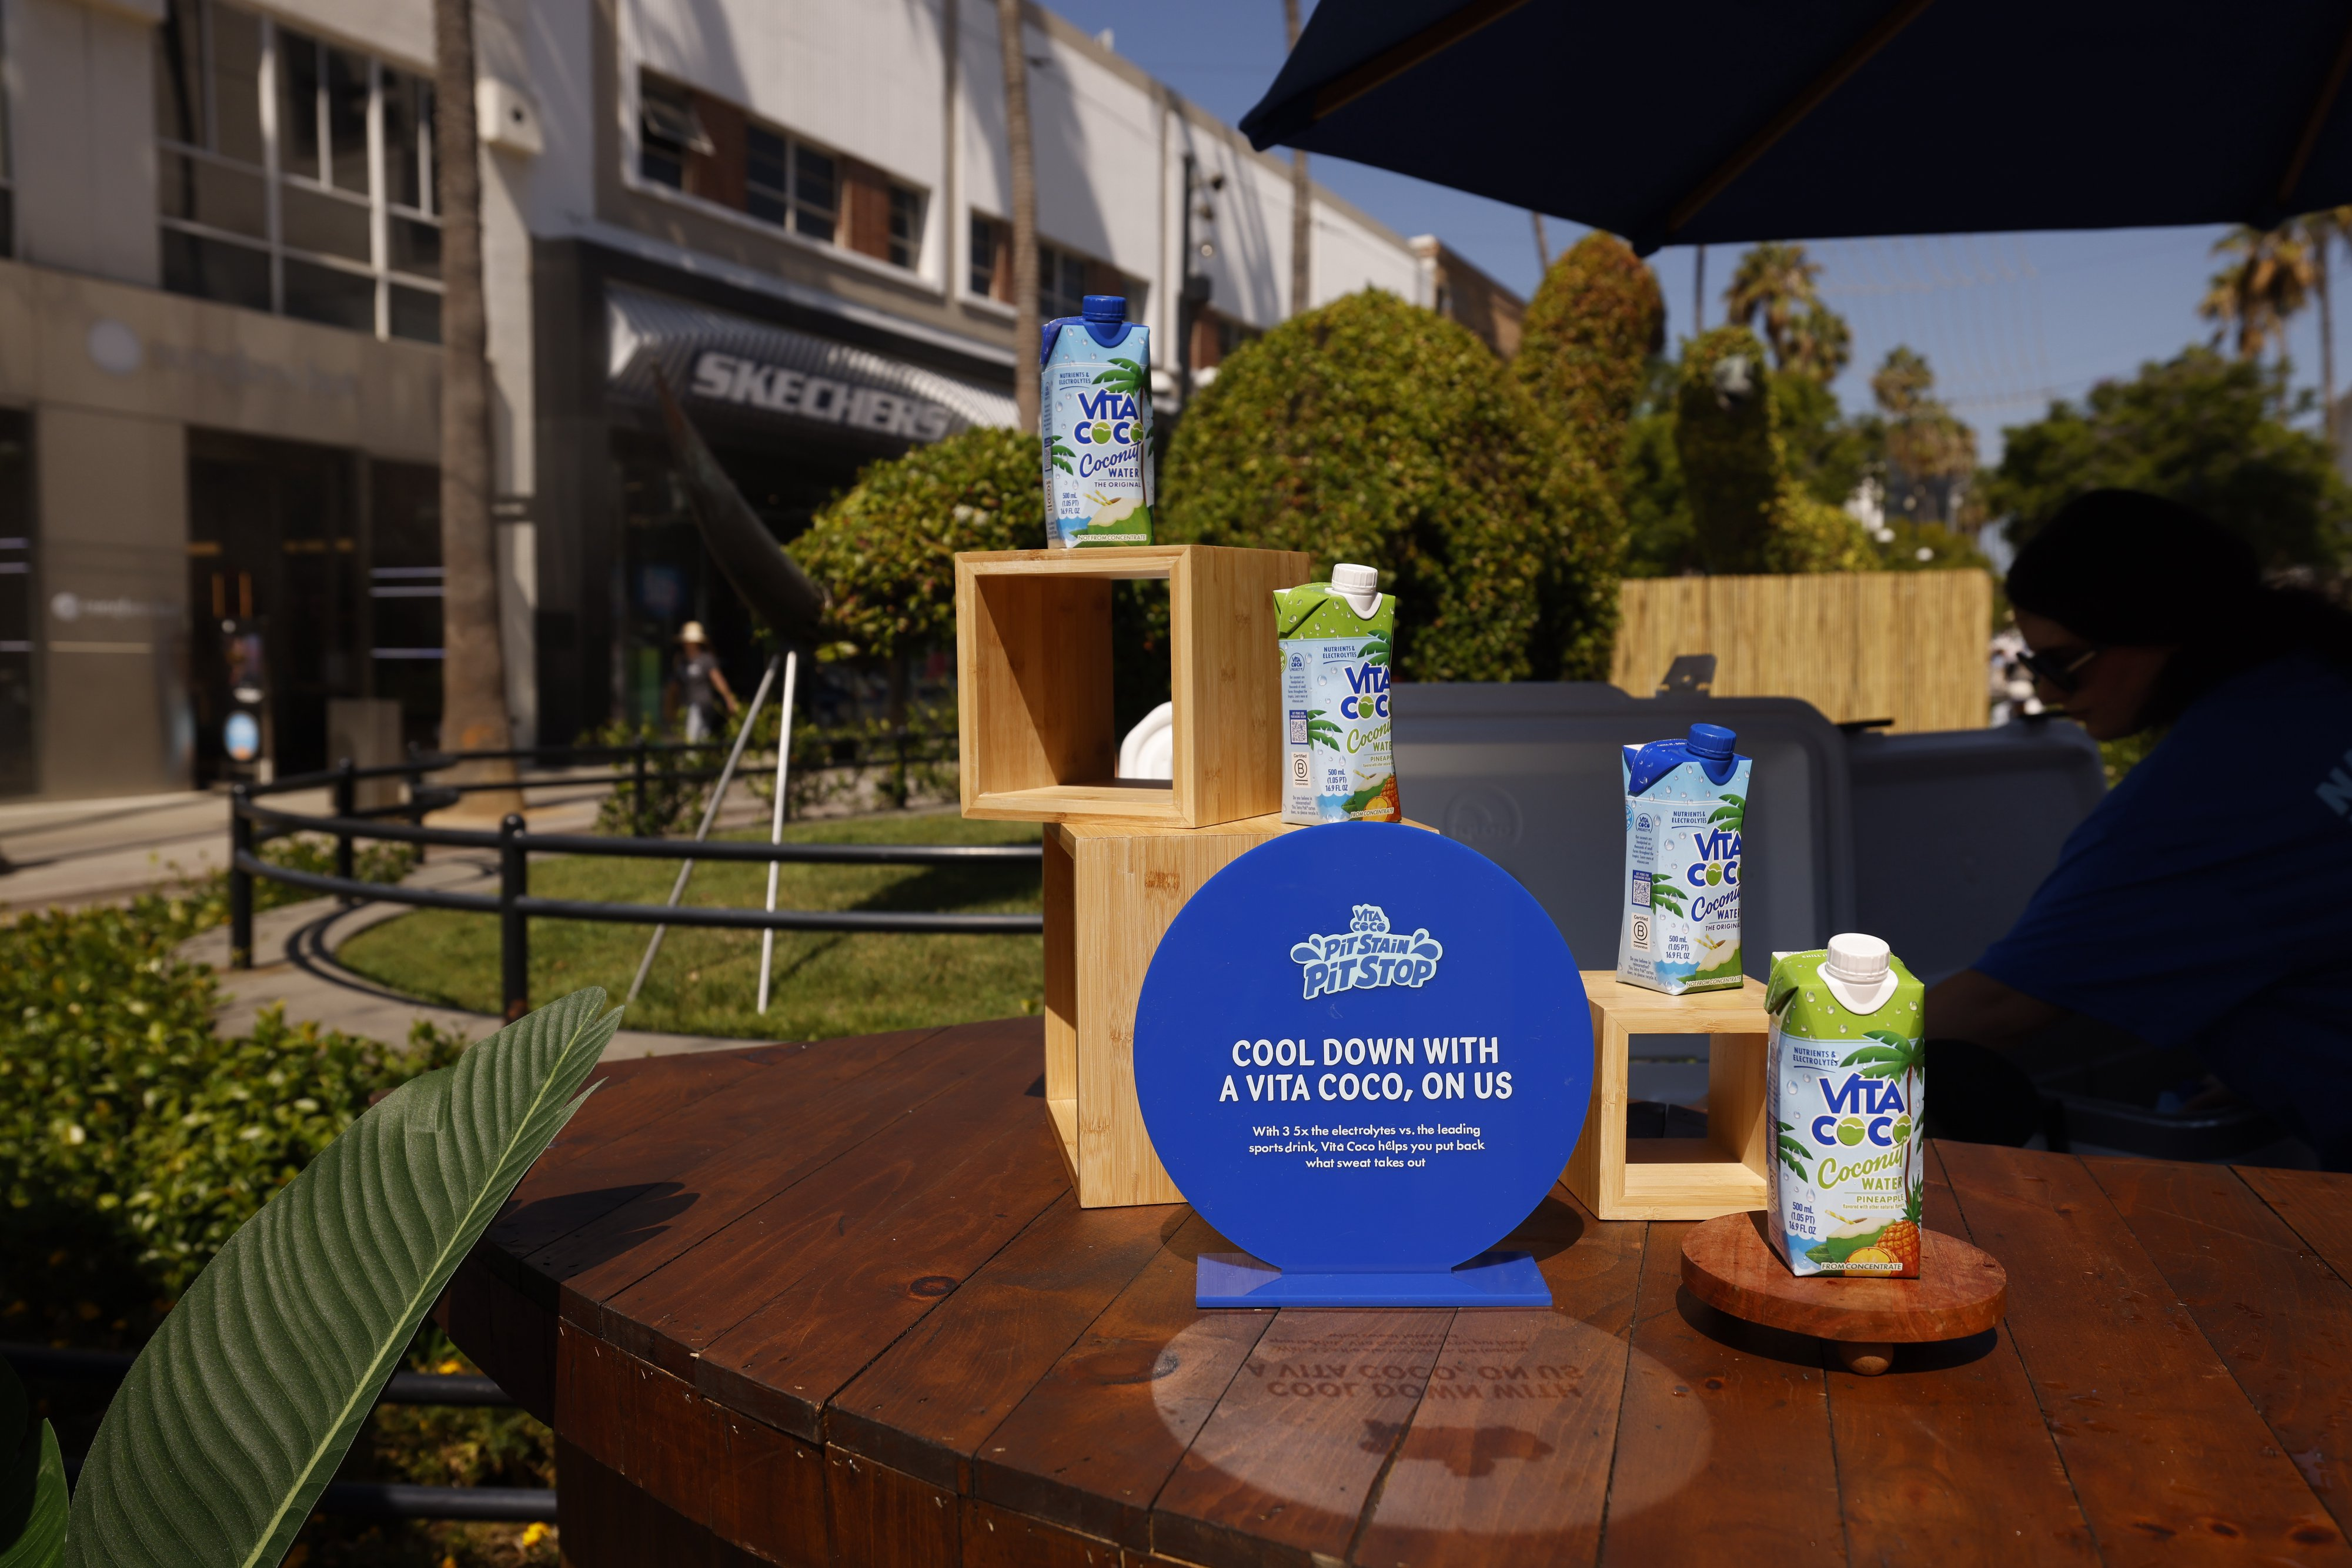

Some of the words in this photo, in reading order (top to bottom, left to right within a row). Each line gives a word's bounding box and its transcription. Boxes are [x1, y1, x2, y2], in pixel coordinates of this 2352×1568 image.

[691, 351, 951, 442] SKECHERS
[1077, 388, 1139, 420] VITA
[1074, 421, 1144, 444] COCO
[1080, 440, 1141, 478] Coconut
[1108, 468, 1139, 477] WATER
[1344, 661, 1390, 694] VITA
[1341, 694, 1391, 720] COC
[1373, 741, 1392, 751] WATE
[1364, 808, 1394, 816] CONCENTRATE
[1693, 828, 1741, 861] VITA
[1354, 908, 1382, 922] VITA
[1352, 922, 1386, 932] COCO
[1355, 955, 1432, 987] STOP
[1710, 976, 1741, 985] CONCENTRATE
[1232, 1038, 1315, 1066] COOL
[1323, 1038, 1414, 1065] DOWN
[1422, 1037, 1498, 1065] WITH
[1794, 1047, 1829, 1058] NUTRIENTS
[1793, 1054, 1838, 1066] ELECTROLYTES
[1219, 1075, 1239, 1102] A
[1246, 1074, 1311, 1102] VITA
[1318, 1072, 1414, 1102] COCO,
[1421, 1072, 1465, 1100] ON
[1474, 1071, 1513, 1099] US
[1819, 1073, 1906, 1114] VITA
[1252, 1125, 1279, 1136] With
[1311, 1125, 1329, 1136] the
[1332, 1125, 1396, 1138] electrolytes
[1417, 1124, 1435, 1135] the
[1438, 1123, 1481, 1137] leading
[1812, 1115, 1911, 1146] COCO
[1249, 1143, 1283, 1155] sports
[1285, 1141, 1318, 1153] drink,
[1321, 1142, 1344, 1151] Vita
[1347, 1141, 1375, 1151] Coco
[1378, 1140, 1408, 1154] helps
[1410, 1144, 1432, 1154] you
[1436, 1142, 1454, 1154] put
[1456, 1139, 1485, 1151] back
[1305, 1157, 1334, 1168] what
[1337, 1158, 1371, 1168] sweat
[1374, 1156, 1404, 1167] takes
[1407, 1158, 1426, 1167] out
[1818, 1138, 1907, 1189] Coconut
[1862, 1176, 1903, 1191] WATER
[1857, 1194, 1904, 1203] PINEAPPLE
[1793, 1202, 1803, 1211] 500
[1804, 1205, 1813, 1213] mL
[1791, 1212, 1804, 1222] (1.05
[1805, 1215, 1815, 1225] PT)
[1789, 1221, 1799, 1231] 16.9
[1800, 1225, 1807, 1233] FL
[1809, 1226, 1816, 1235] OZ
